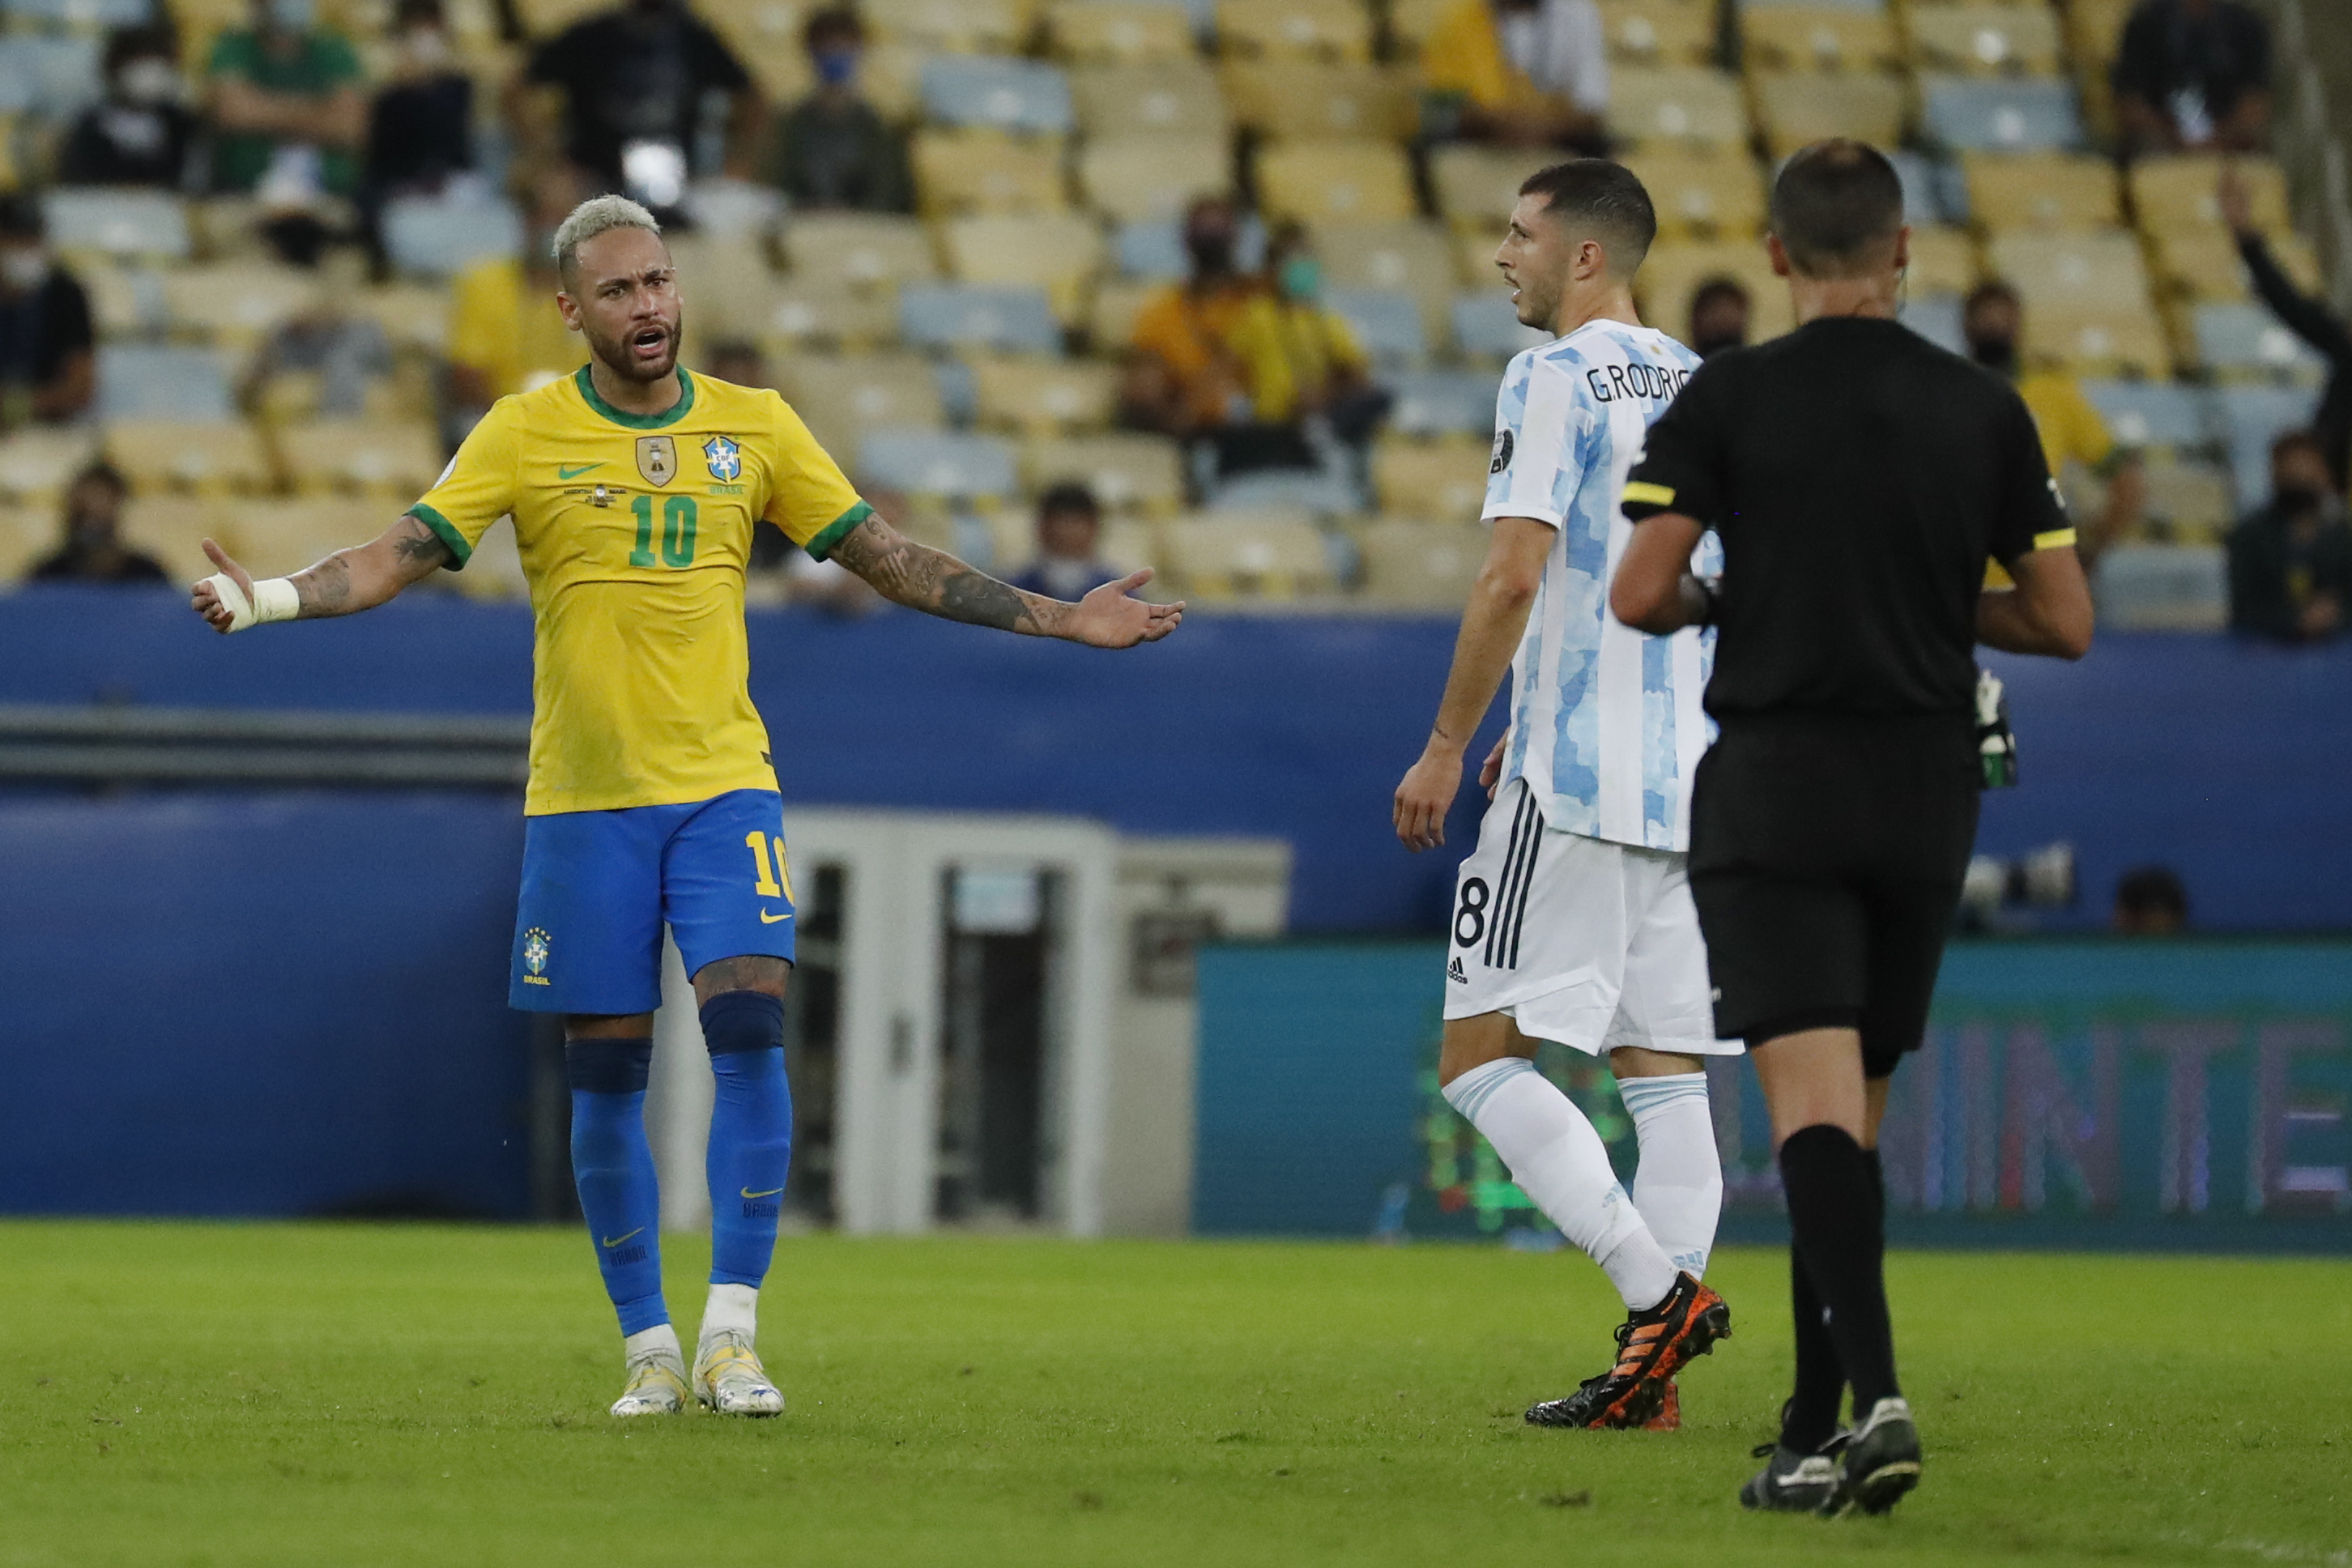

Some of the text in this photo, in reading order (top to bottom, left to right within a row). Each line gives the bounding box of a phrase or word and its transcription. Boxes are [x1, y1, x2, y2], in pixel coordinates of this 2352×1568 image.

[709, 485, 744, 496] BRASIL
[629, 495, 697, 568] 10
[1455, 877, 1489, 948] 8
[523, 975, 551, 986] BRASIL
